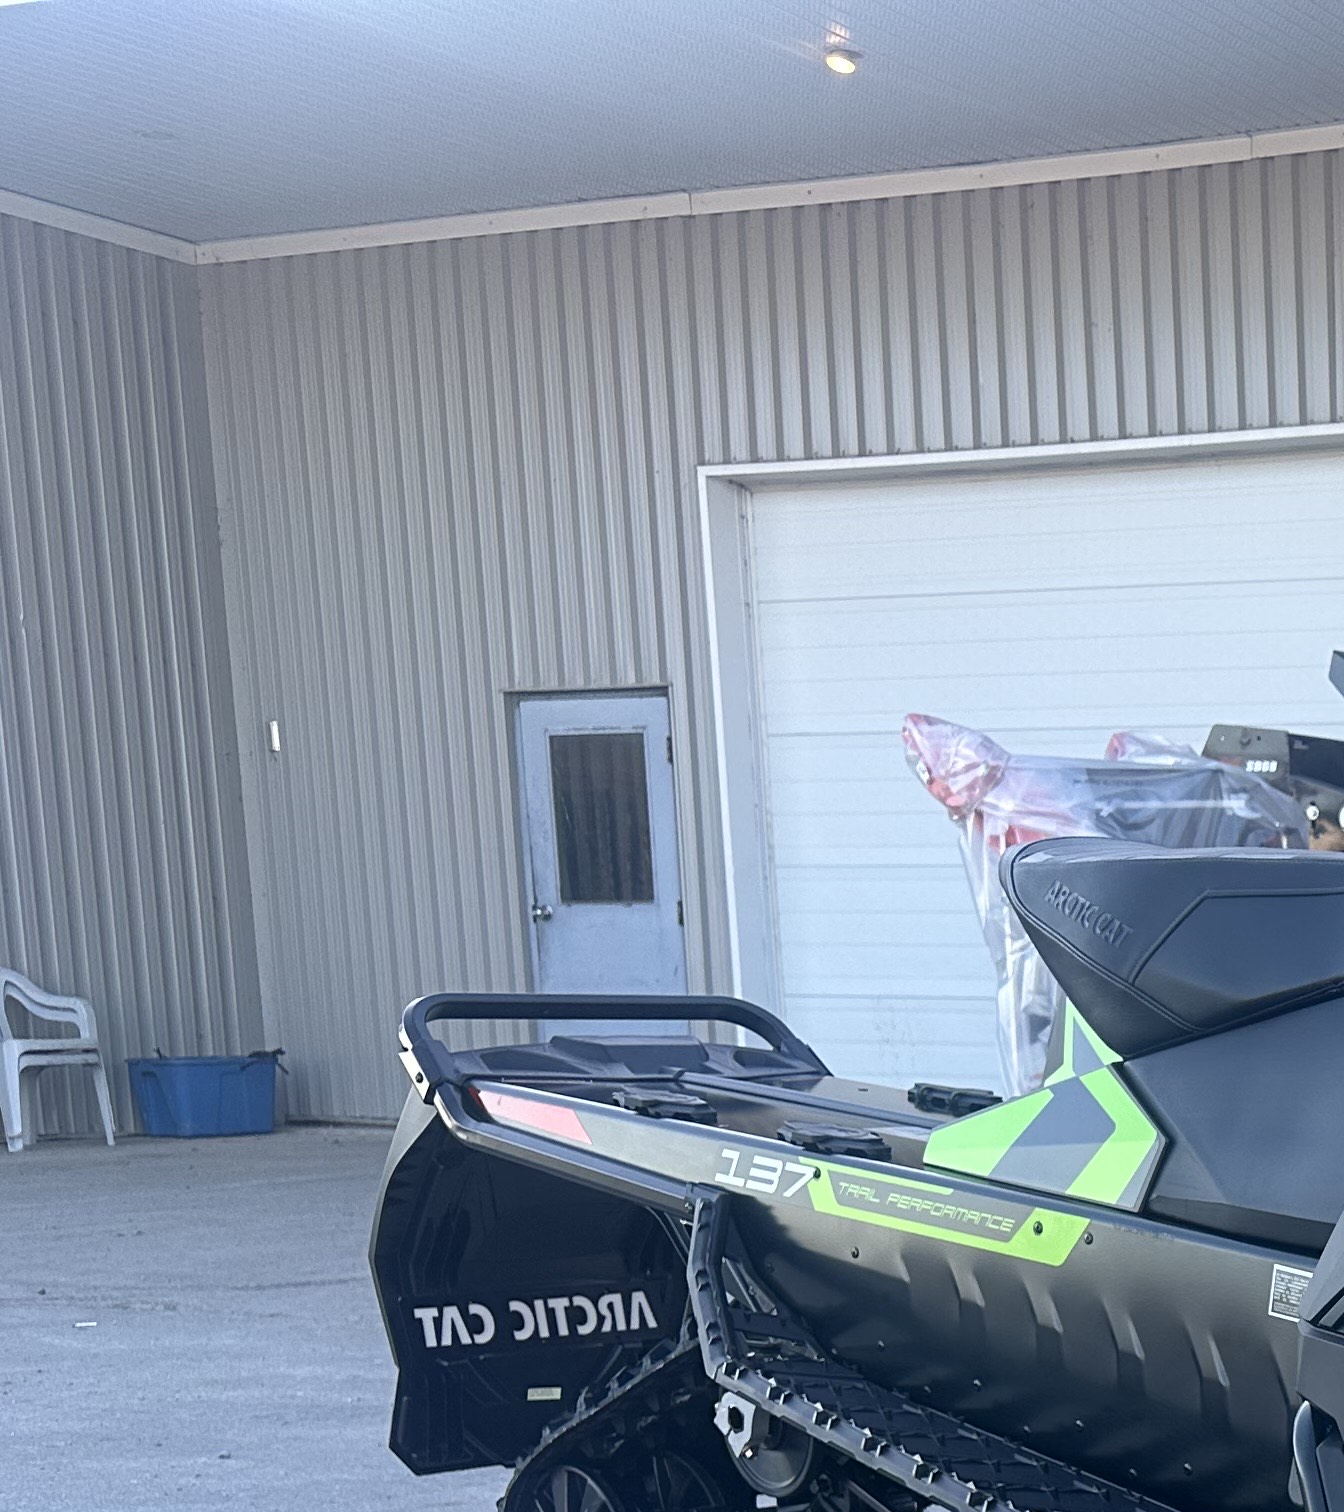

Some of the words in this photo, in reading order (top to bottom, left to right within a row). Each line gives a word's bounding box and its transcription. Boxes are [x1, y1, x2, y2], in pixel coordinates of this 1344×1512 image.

[1044, 880, 1095, 930] ARCTIC
[1092, 909, 1134, 948] CAT
[715, 1148, 817, 1198] 137
[838, 1181, 880, 1203] TRAIL
[886, 1192, 1016, 1232] PERFORMANCE
